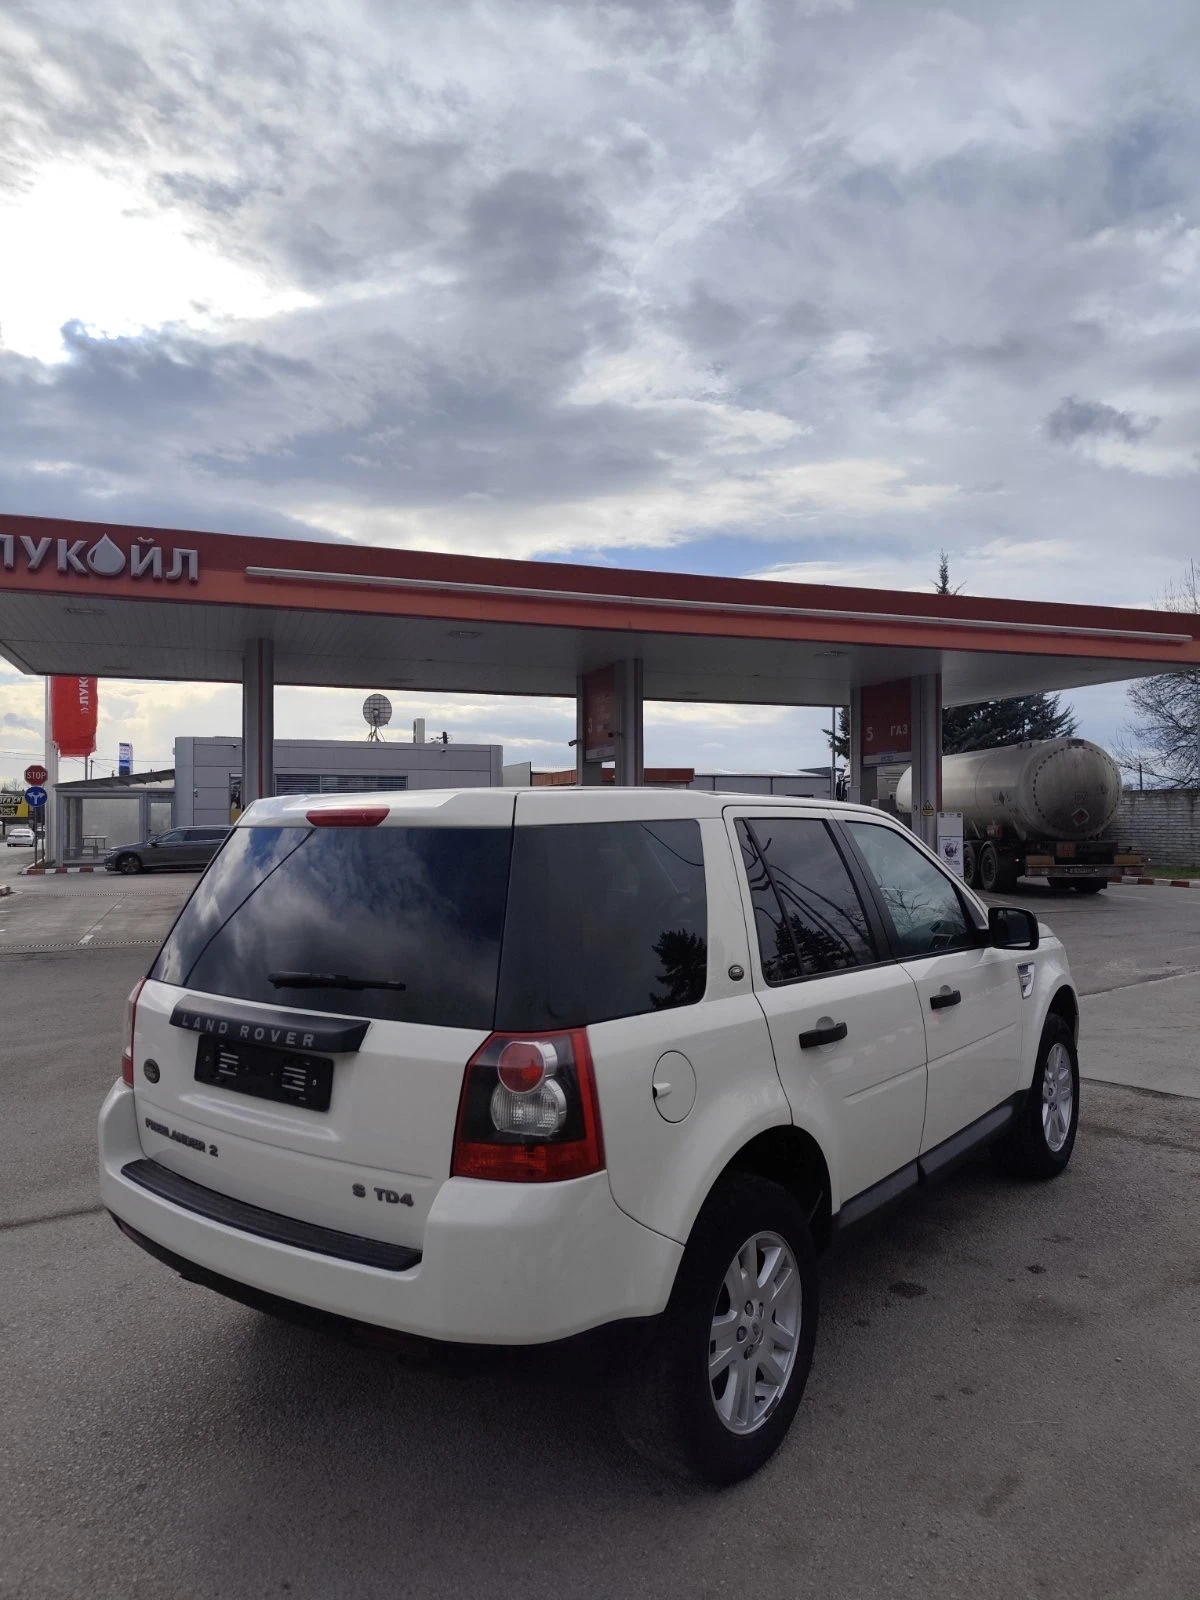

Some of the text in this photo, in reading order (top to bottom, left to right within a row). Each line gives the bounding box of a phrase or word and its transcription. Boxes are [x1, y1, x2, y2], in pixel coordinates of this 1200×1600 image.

[866, 726, 874, 741] 5
[890, 724, 909, 736] ГАЗ
[27, 771, 46, 780] STOP
[182, 1014, 315, 1047] LAND ROVER
[145, 1117, 219, 1158] FREELANDER 2
[352, 1183, 414, 1207] S TD4
